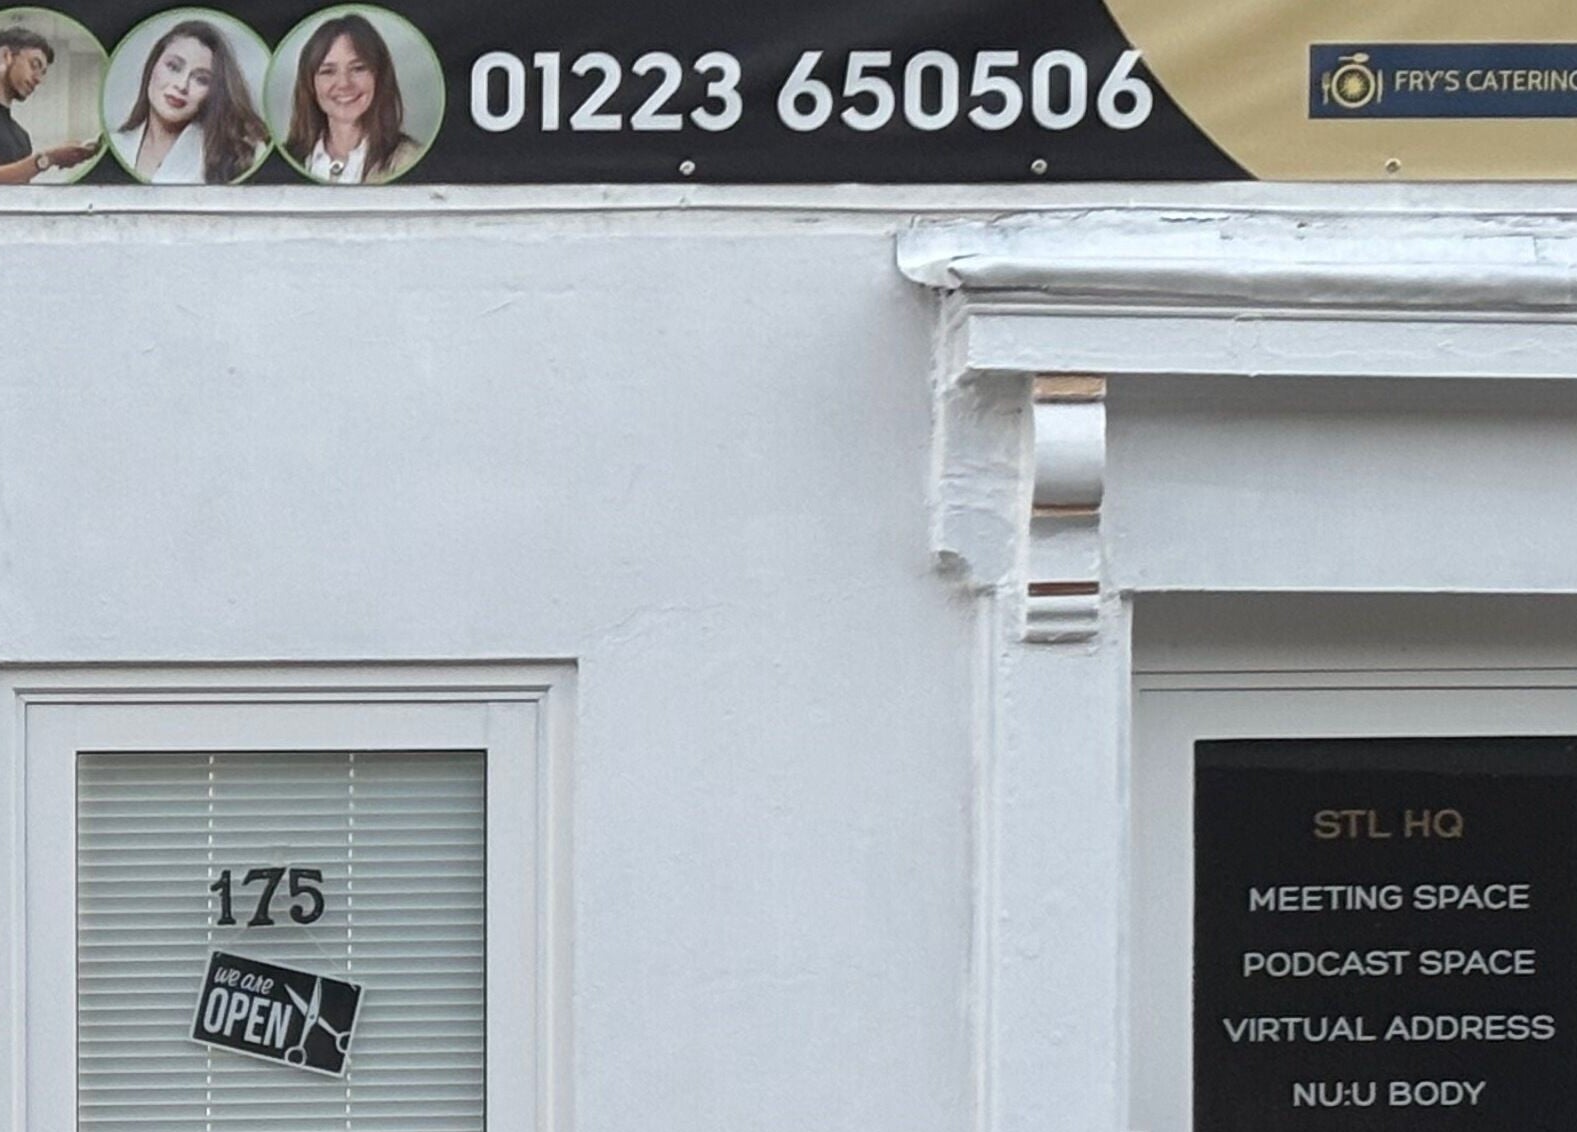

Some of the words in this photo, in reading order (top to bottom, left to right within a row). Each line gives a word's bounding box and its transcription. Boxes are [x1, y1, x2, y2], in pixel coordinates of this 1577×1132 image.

[469, 50, 743, 132] 01223
[777, 50, 1153, 132] 650506
[1394, 70, 1460, 92] FRY'S
[1313, 809, 1391, 839] STL
[1404, 808, 1465, 838] HQ
[210, 866, 325, 927] 175
[1249, 885, 1403, 912] MEETING
[1413, 884, 1530, 911] SPACE
[1243, 951, 1410, 977] PODCAST
[1419, 949, 1536, 976] SPACE
[214, 965, 241, 987] we
[241, 974, 274, 995] are
[203, 987, 293, 1049] OPEN
[1223, 1016, 1377, 1042] VIRTUAL
[1384, 1015, 1556, 1041] ADDRESS
[1389, 1081, 1486, 1106] BODY
